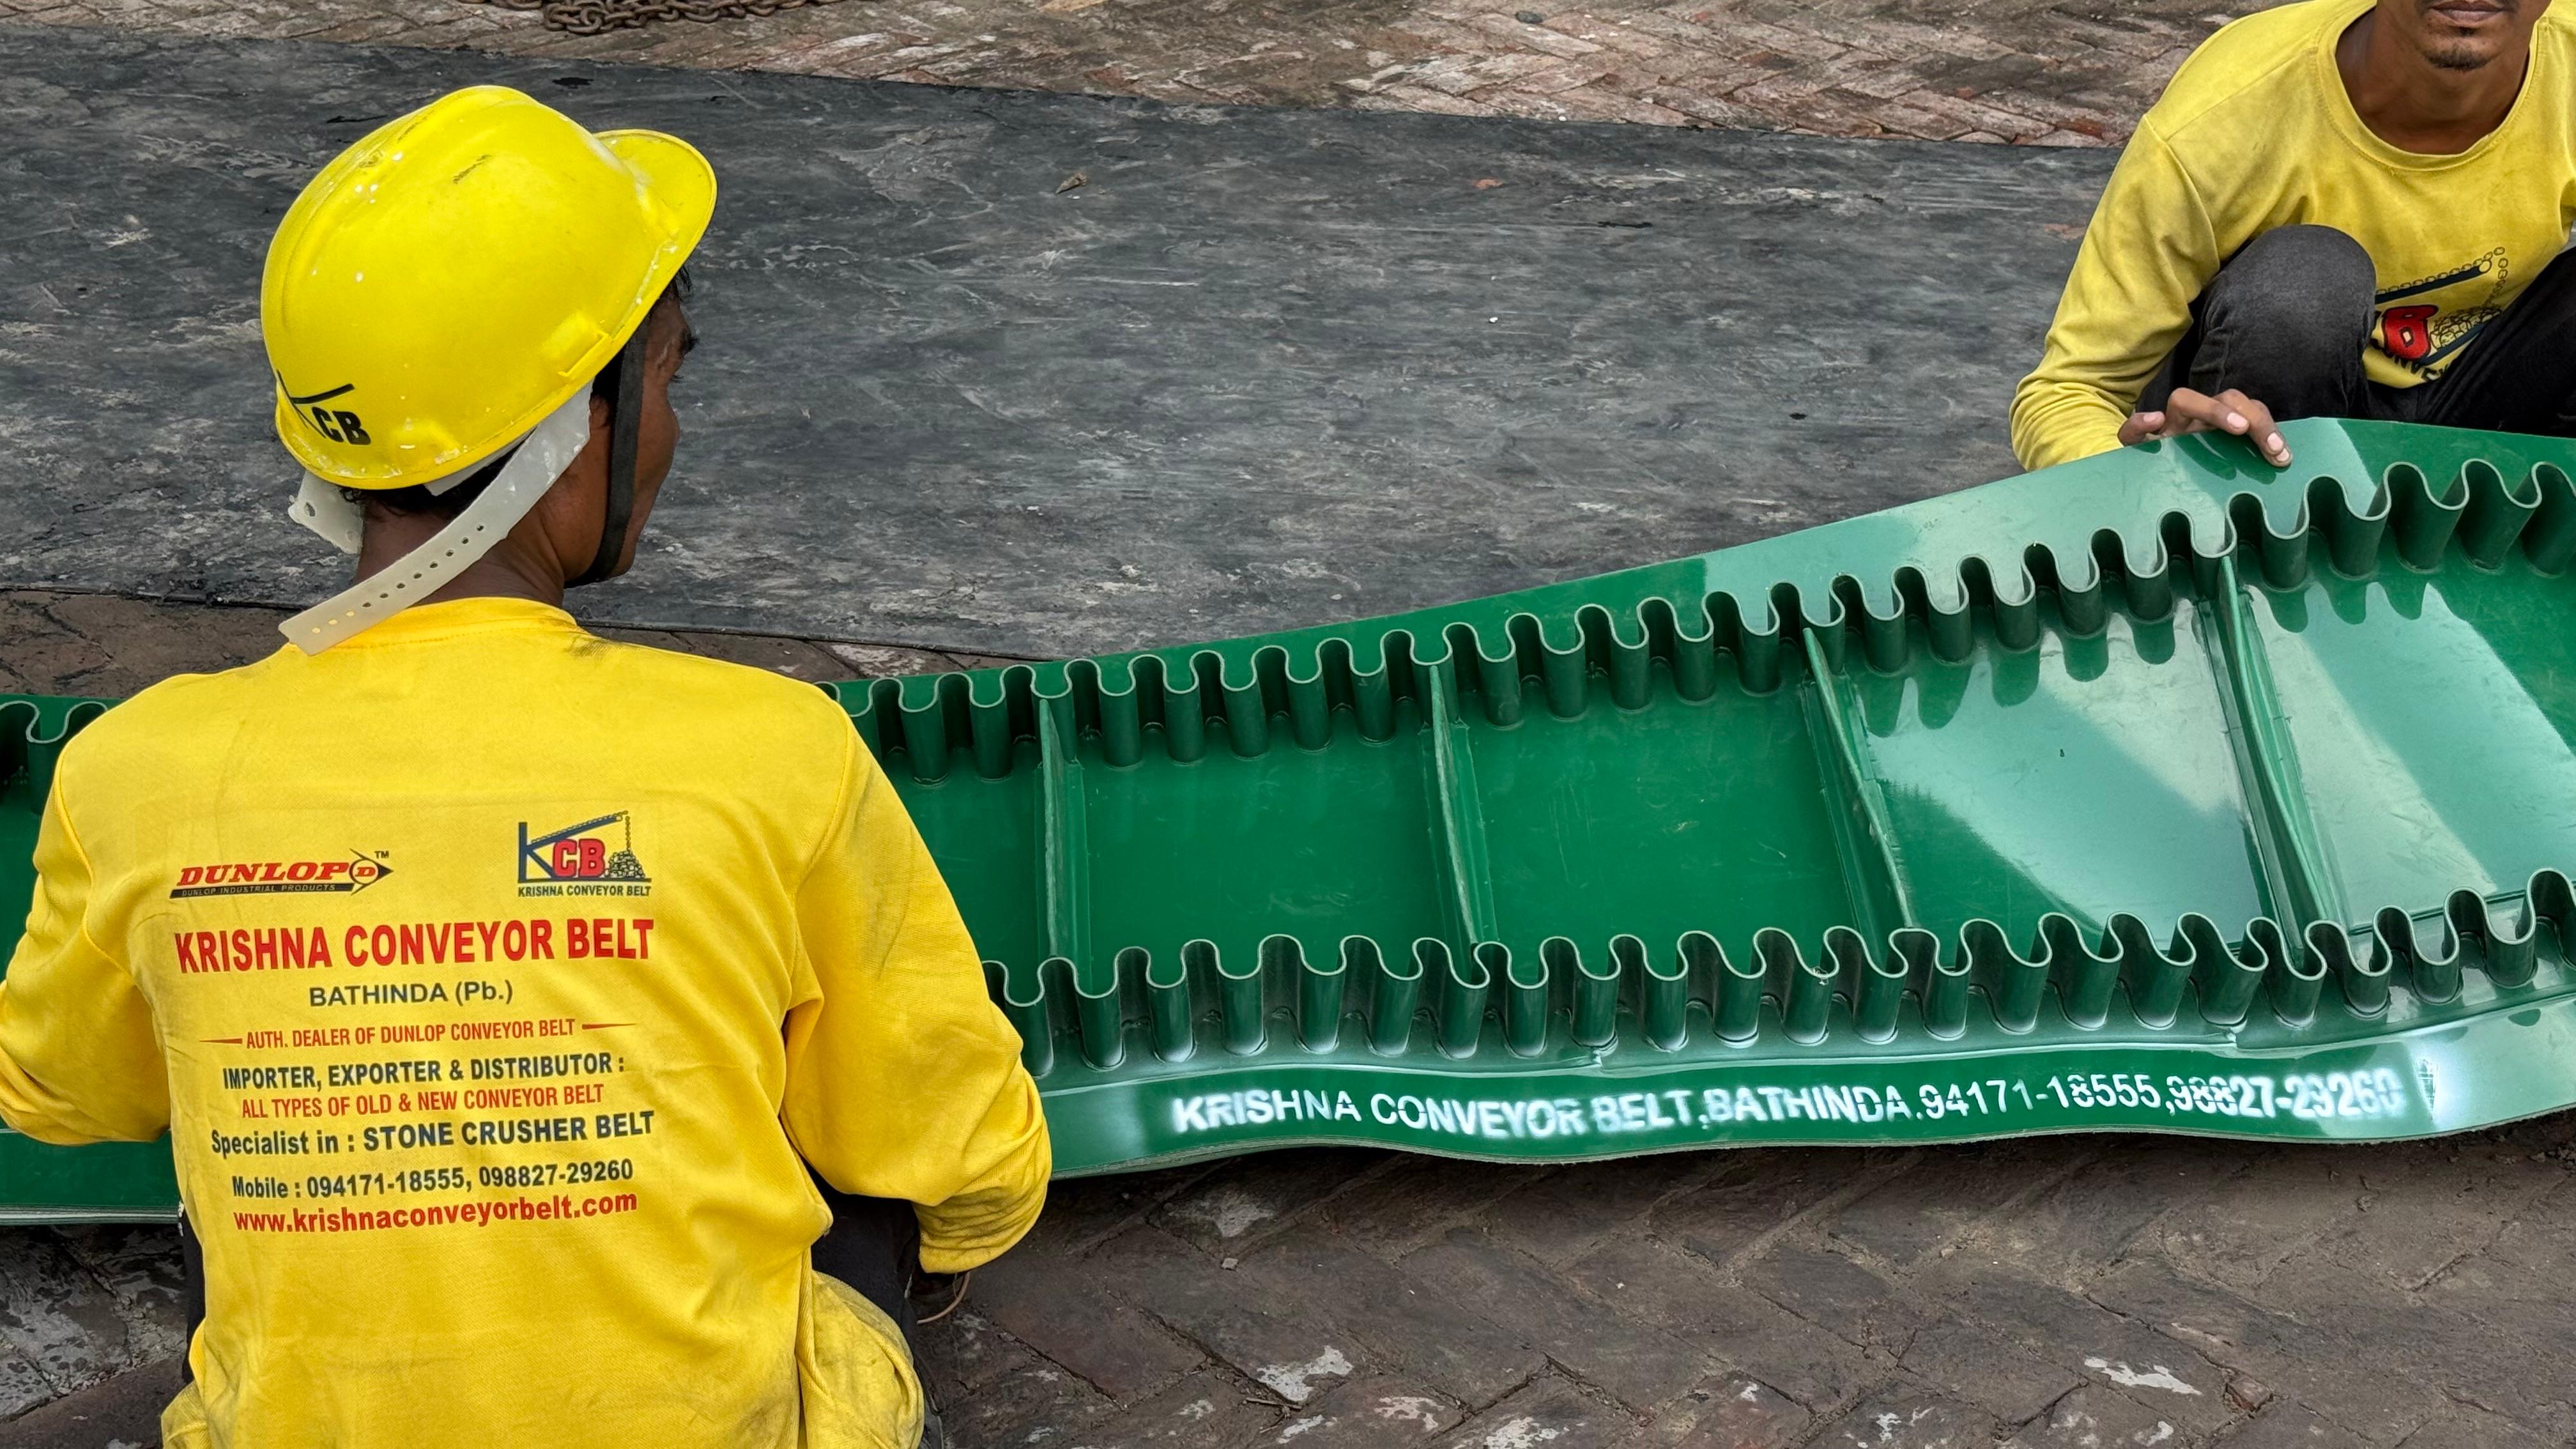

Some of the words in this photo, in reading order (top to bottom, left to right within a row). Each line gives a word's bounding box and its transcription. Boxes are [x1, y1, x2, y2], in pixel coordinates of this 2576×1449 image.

[518, 813, 623, 882] KCB
[176, 862, 350, 886] DUNLOP
[181, 887, 216, 896] DUNLOP
[220, 885, 276, 894] INDUSTRIAL
[281, 884, 336, 892] PRODUCTS
[518, 885, 564, 897] KRISHNA
[567, 885, 624, 896] CONVEYOR
[627, 885, 652, 896] BELT
[174, 926, 332, 974] KRISHNA
[344, 919, 555, 967] CONVEYOR
[567, 918, 654, 960] BELT
[309, 982, 448, 1007] BATHINDA
[456, 979, 513, 1006] (Pb.)
[247, 1030, 288, 1049] AUTH.
[293, 1028, 350, 1047] DEALER
[355, 1027, 376, 1045] OF
[381, 1023, 446, 1043] DUNLOP
[450, 1021, 534, 1041] CONVEYOR
[539, 1018, 576, 1037] BELT
[223, 1066, 322, 1092] IMPORTER,
[328, 1060, 442, 1087] EXPORTER
[449, 1059, 464, 1080] &
[242, 1098, 268, 1118] ALL
[272, 1098, 323, 1118] TYPES
[328, 1096, 351, 1117] OF
[356, 1094, 392, 1115] OLD
[398, 1092, 411, 1112] &
[417, 1090, 458, 1111] NEW
[463, 1086, 558, 1110] CONVEYOR
[564, 1084, 604, 1105] BELT
[1172, 1089, 1362, 1133] KRISHNA
[1370, 1092, 1588, 1138] CONVEYOR
[211, 1129, 310, 1160] Specialist
[317, 1130, 339, 1154] in
[363, 1122, 454, 1152] STONE
[461, 1116, 588, 1146] CRUSHER
[595, 1110, 655, 1139] BELT
[232, 1176, 289, 1199] Mobile
[307, 1167, 472, 1198] 094171-18555,
[479, 1158, 634, 1188] 098827-29260
[233, 1193, 637, 1232] www.krishnaconveyorbelt.com
